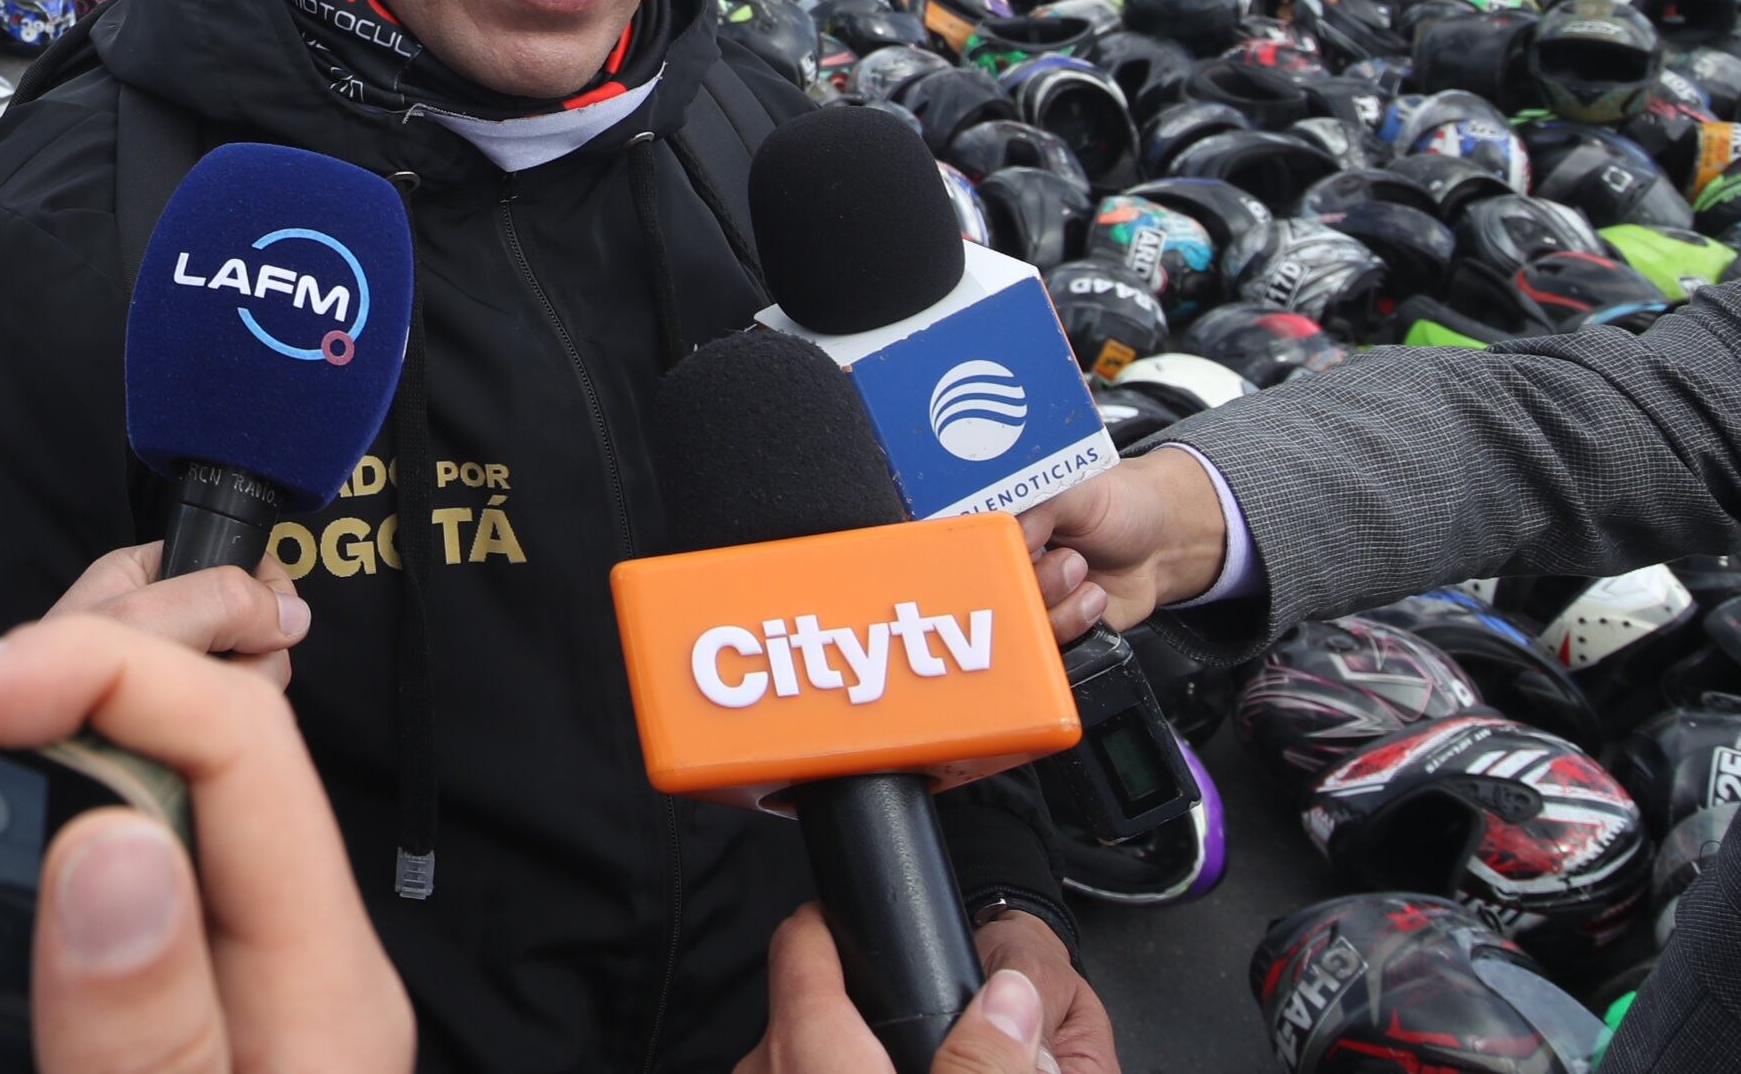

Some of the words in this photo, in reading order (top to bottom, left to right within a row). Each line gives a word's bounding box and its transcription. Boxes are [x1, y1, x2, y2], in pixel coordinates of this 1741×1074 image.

[173, 252, 350, 322] LAFM
[435, 460, 512, 490] POR
[961, 447, 1099, 516] LENOTICIAS
[691, 601, 994, 708] Citytv
